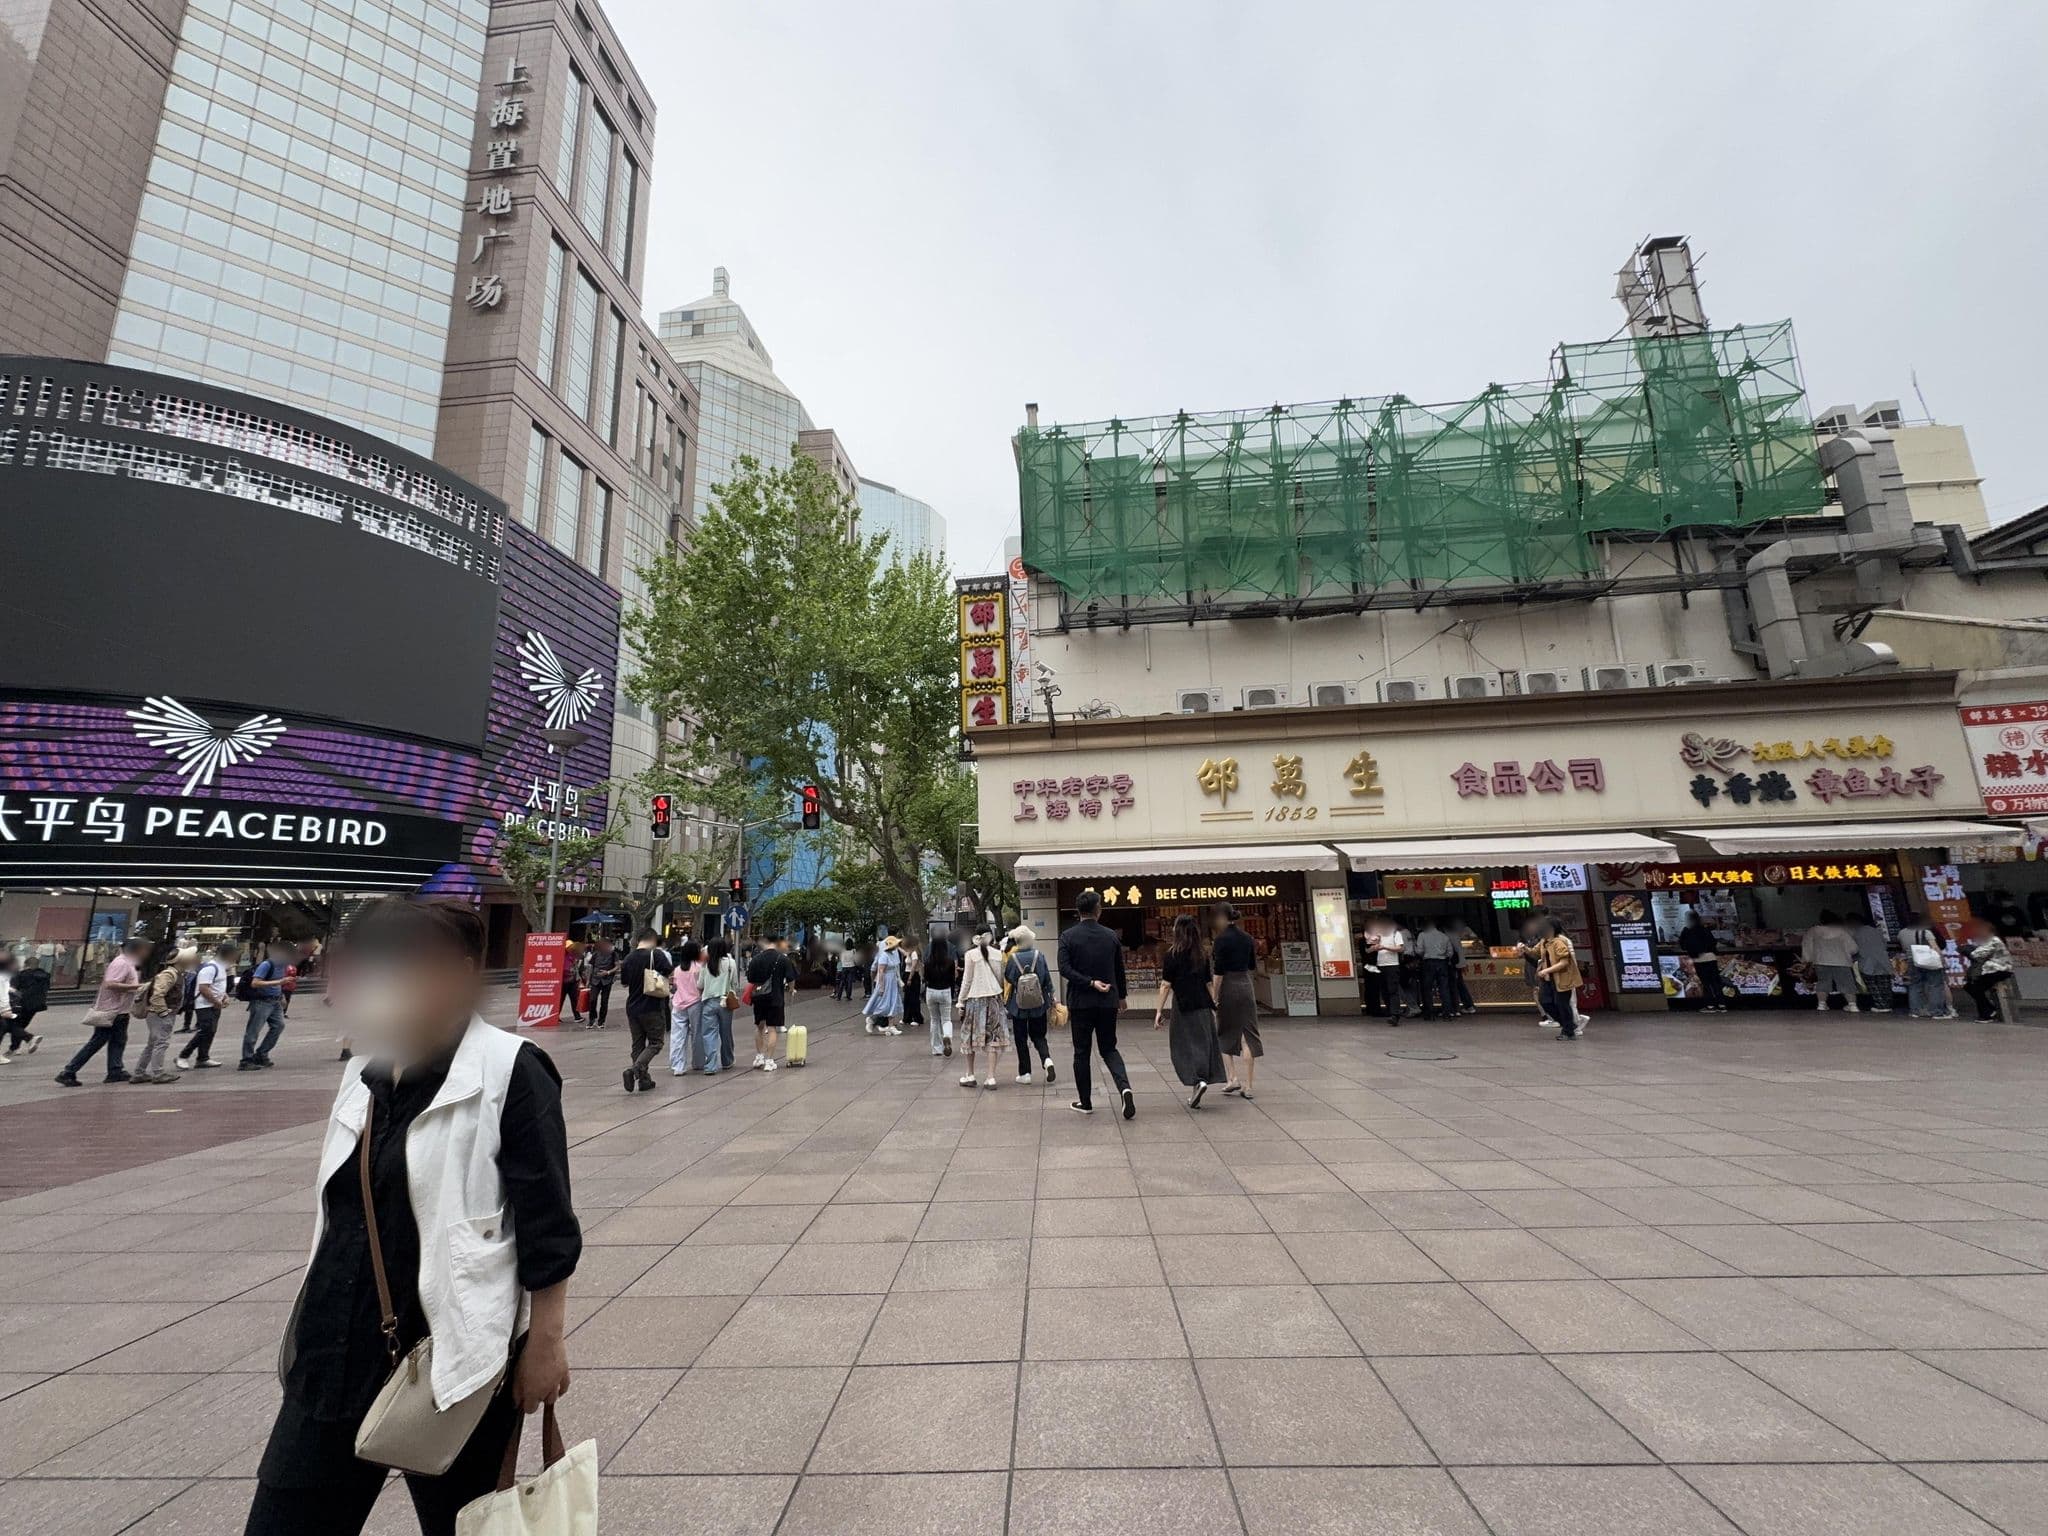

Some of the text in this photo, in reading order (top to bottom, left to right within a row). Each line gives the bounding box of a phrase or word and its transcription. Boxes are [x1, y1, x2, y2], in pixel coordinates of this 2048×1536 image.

[465, 57, 528, 308] 上海置地广场
[970, 601, 998, 726] 邵萬生
[1752, 734, 1895, 763] 大阪人气美食
[1013, 775, 1134, 799] 中华老字号
[1196, 751, 1384, 808] 邵萬生
[1450, 758, 1606, 797] 食品公司
[1804, 765, 1945, 804] 章鱼丸子
[1014, 797, 1135, 821] 上海特产
[1265, 806, 1318, 822] 1852
[144, 806, 387, 847] PEACEBIRD
[1668, 870, 1753, 885] 大阪人气美食
[1789, 863, 1883, 880] 日式铁板烧
[1084, 886, 1143, 906] 珍香
[1155, 884, 1277, 900] BEE CHENG HIANG
[524, 1004, 554, 1018] RUN
